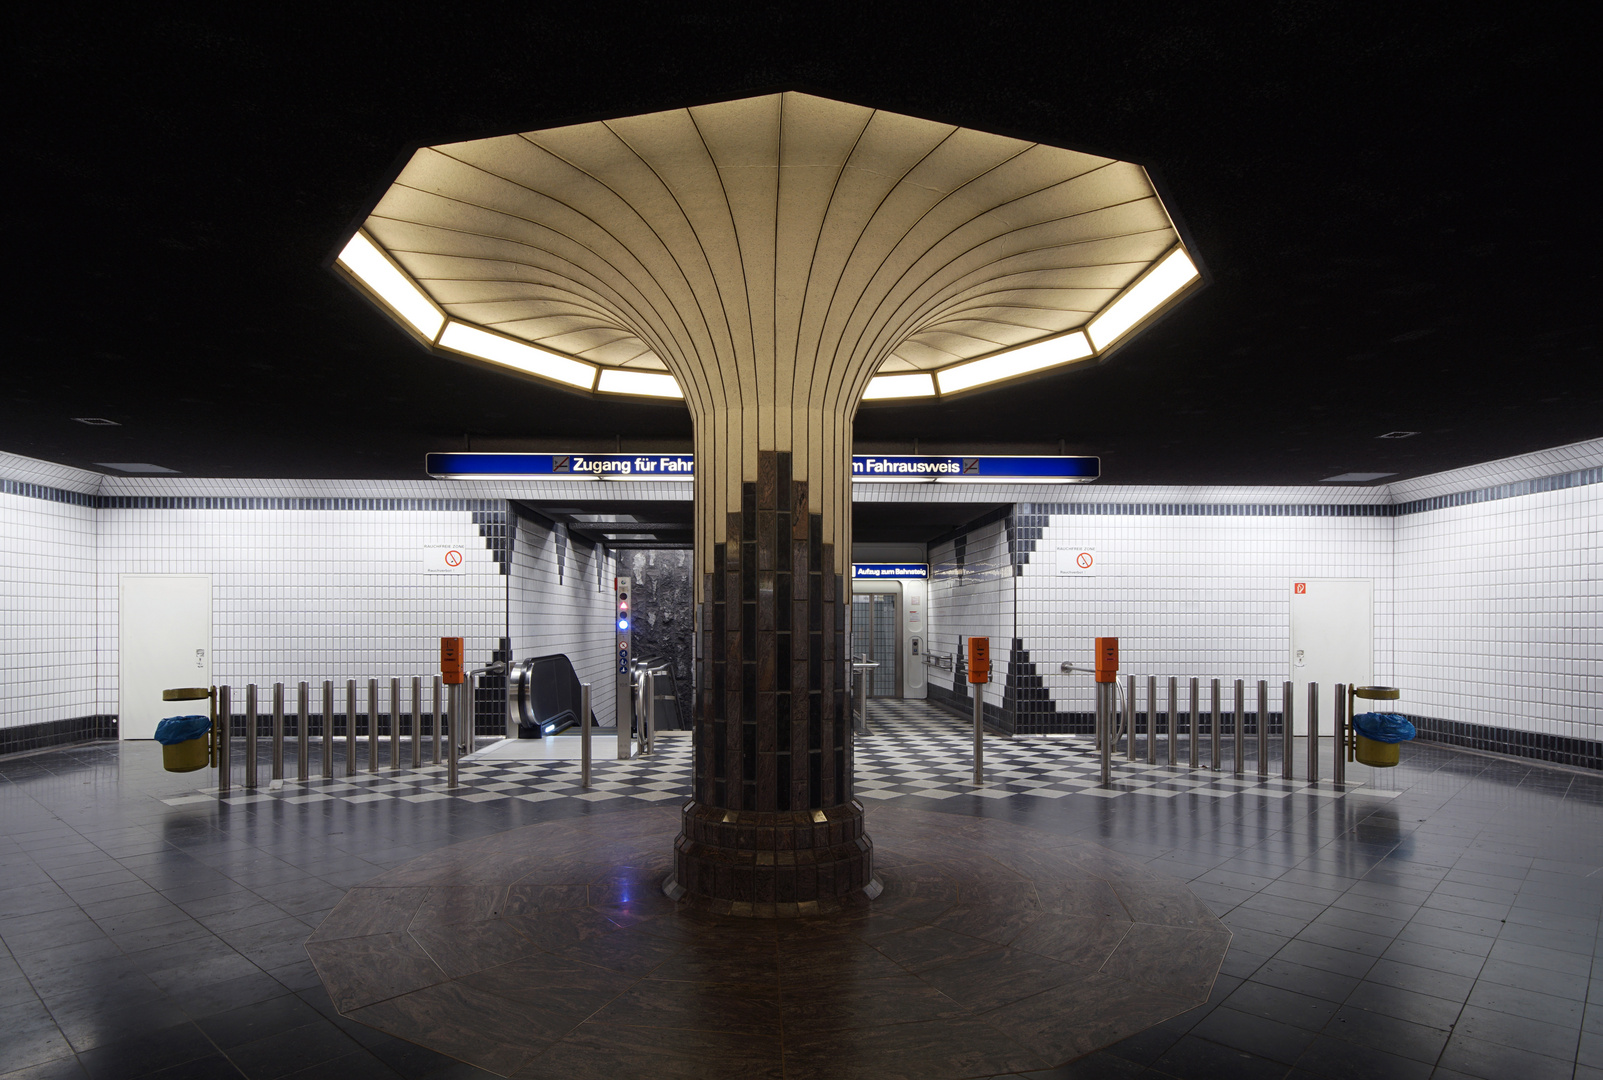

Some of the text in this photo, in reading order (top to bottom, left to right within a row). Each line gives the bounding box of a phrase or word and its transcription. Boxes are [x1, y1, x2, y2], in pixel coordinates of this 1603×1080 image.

[573, 457, 631, 474] Zugang
[634, 457, 657, 472] für
[660, 457, 693, 472] Fahr
[866, 458, 960, 473] Fahrausweis
[858, 568, 880, 576] Aufzug
[895, 568, 926, 576] Bahnsteig
